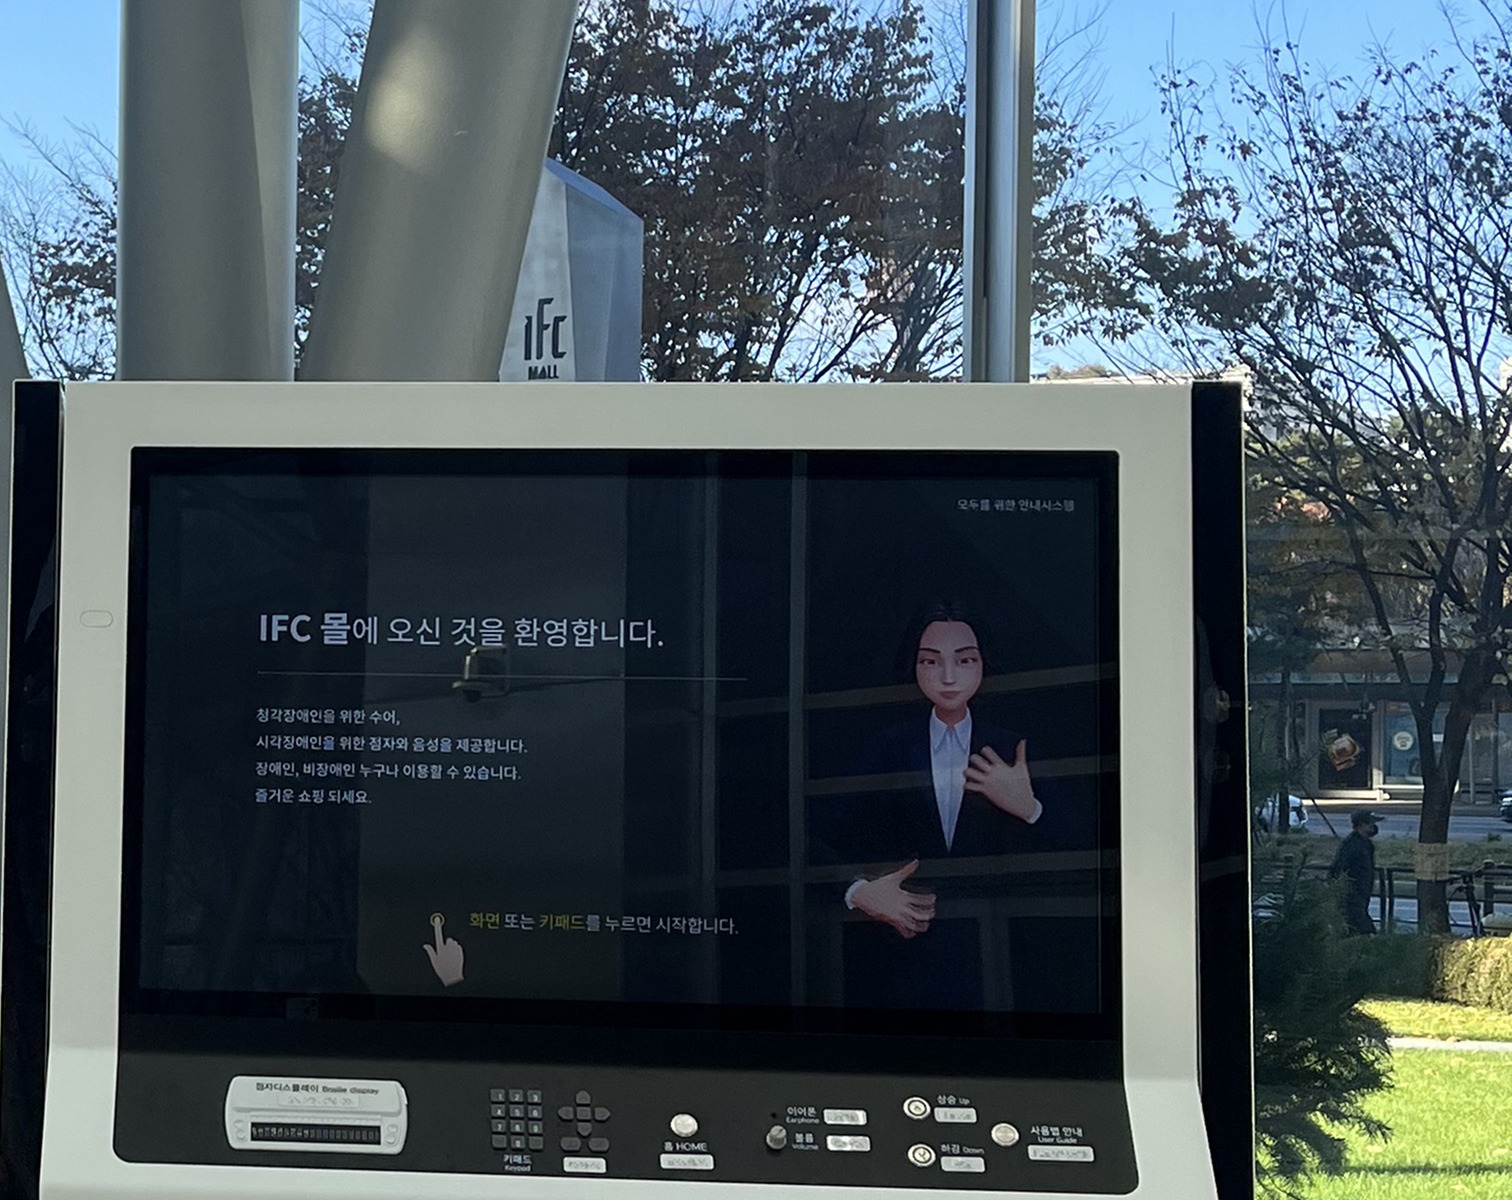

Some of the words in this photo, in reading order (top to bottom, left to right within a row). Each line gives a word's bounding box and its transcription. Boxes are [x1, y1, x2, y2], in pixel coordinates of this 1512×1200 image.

[524, 297, 567, 361] IFC
[528, 364, 559, 380] MALL
[259, 614, 312, 643] IFC
[320, 613, 378, 645] 몰에
[387, 616, 442, 646] 오신
[451, 617, 506, 647] 것을
[514, 618, 665, 649] 환영합니다.
[256, 708, 336, 724] 청각장애인을
[339, 709, 366, 724] 위한
[369, 710, 401, 726] 수어,
[256, 735, 336, 750] 시각장애인을
[339, 736, 366, 750] 위한
[368, 736, 409, 751] 점자와
[412, 737, 453, 752] 음성을
[456, 738, 529, 753] 제공합니다.
[256, 762, 300, 777] 장애인,
[303, 762, 356, 777] 비장애인
[359, 764, 400, 778] 누구나
[403, 764, 442, 779] 이용할
[446, 765, 460, 780] 수
[463, 765, 522, 780] 있습니다.
[255, 788, 295, 803] 즐거운
[298, 789, 325, 803] 쇼핑
[328, 789, 372, 804] 되세요.
[469, 912, 500, 929] 화면
[504, 913, 536, 930] 또는
[539, 914, 601, 932] 키패드를
[605, 915, 652, 933] 누르면
[656, 917, 739, 935] 시작합니다.
[256, 1082, 319, 1093] 점자디스플레이
[350, 1087, 380, 1096] display
[787, 1106, 817, 1118] 이어폰
[786, 1117, 820, 1125] Earphone
[1031, 1125, 1061, 1137] 사용법
[1062, 1126, 1084, 1138] 안내
[676, 1142, 708, 1152] HOME
[1038, 1136, 1055, 1144] User
[1056, 1137, 1078, 1145] Guide
[963, 1146, 986, 1154] Down
[503, 1153, 533, 1166] 키패드
[505, 1165, 531, 1173] Keypad
